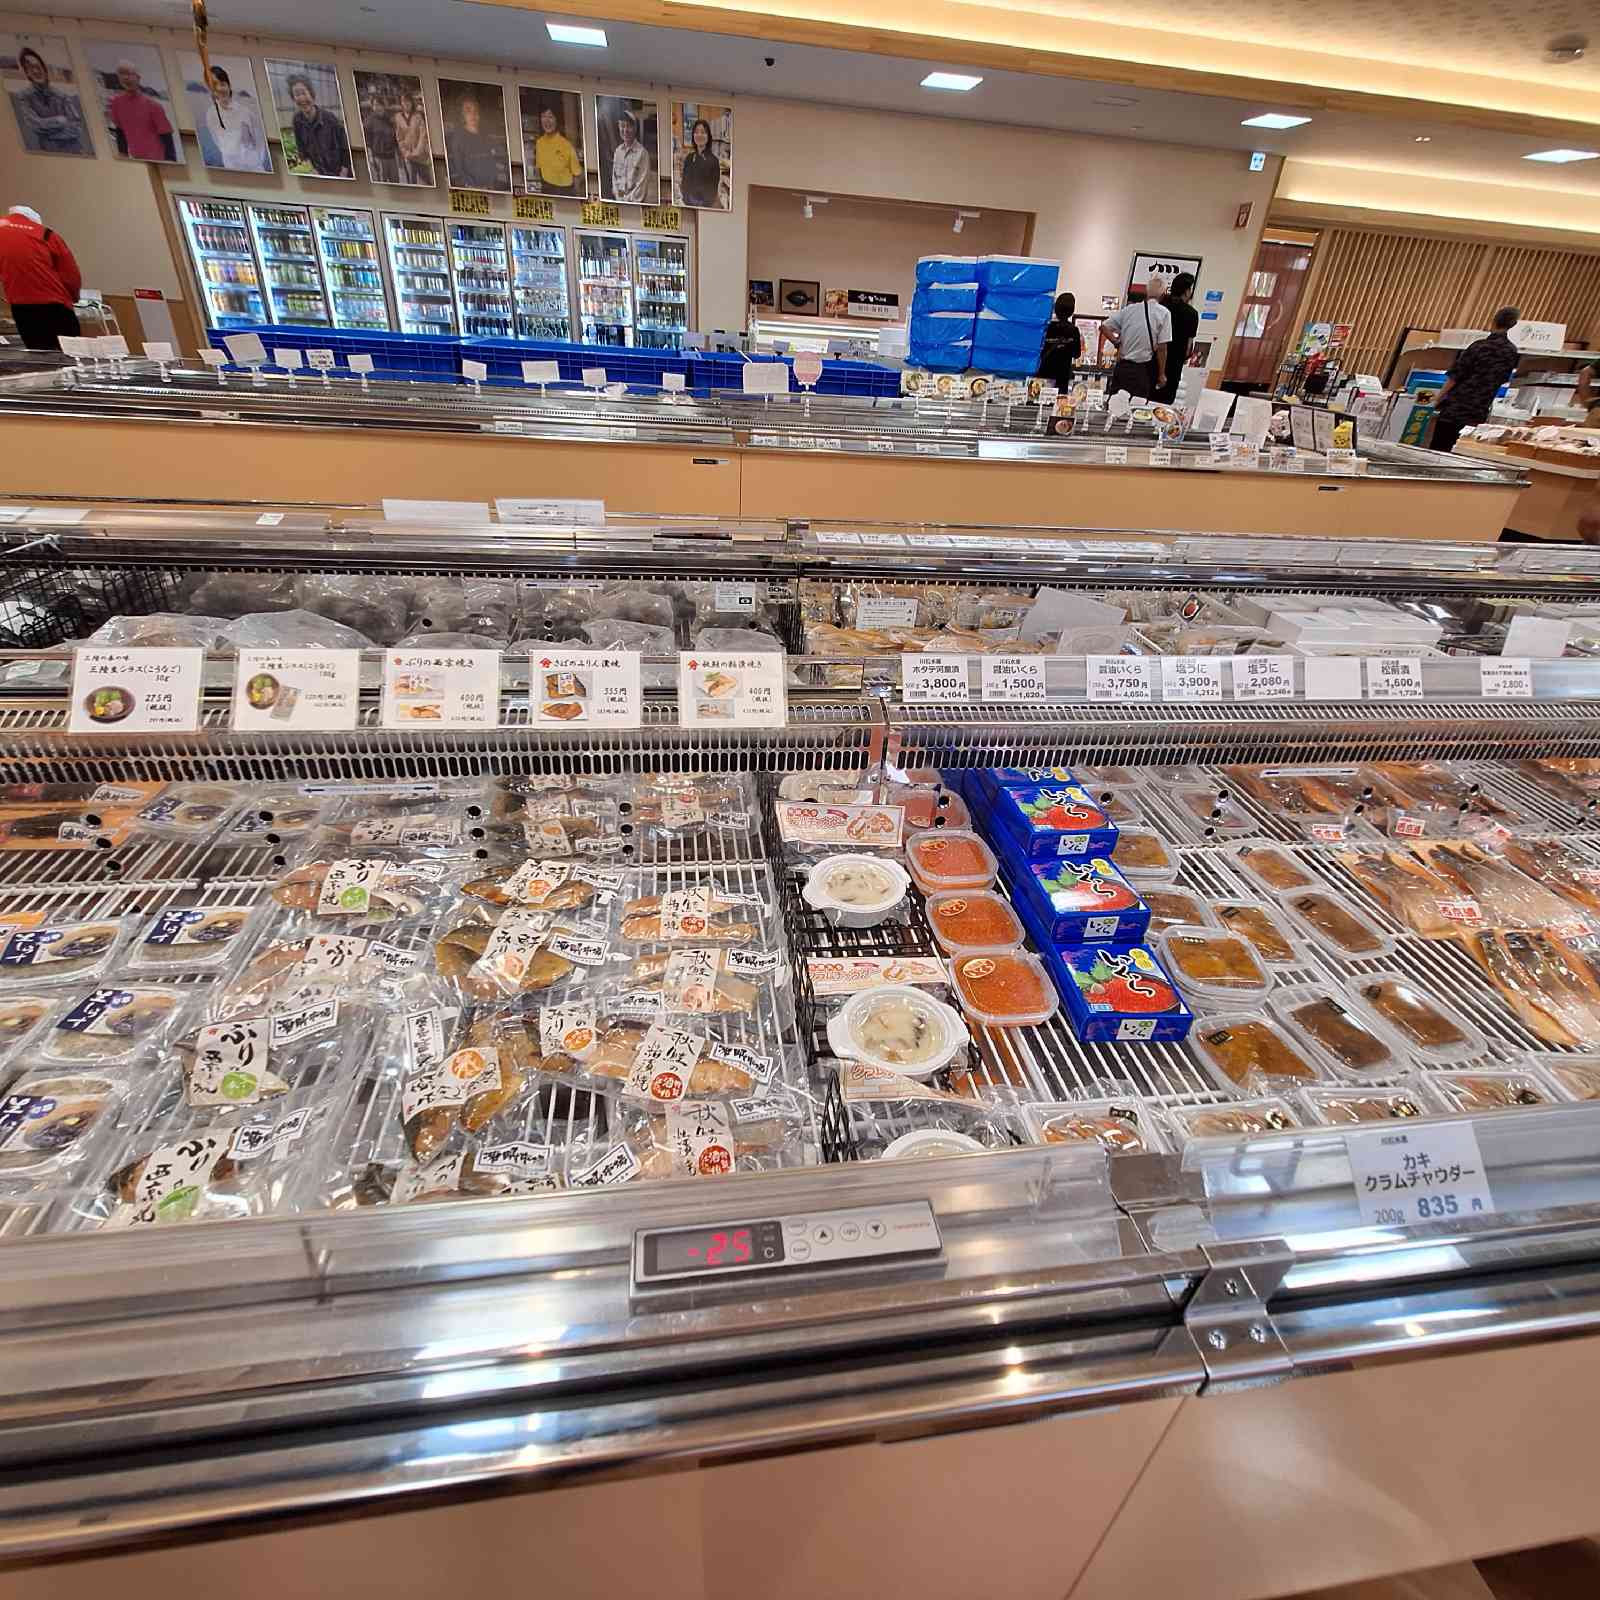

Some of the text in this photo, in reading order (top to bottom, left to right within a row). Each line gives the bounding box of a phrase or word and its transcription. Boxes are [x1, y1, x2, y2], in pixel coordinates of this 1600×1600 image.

[992, 665, 1038, 674] 醤油いくら
[1098, 664, 1142, 674] 醤油いくら
[1176, 663, 1208, 673] 塩うに
[1248, 663, 1279, 674] 塩うに
[1402, 1152, 1430, 1170] カキ
[1365, 1164, 1476, 1192] クラムチャウダー
[1375, 1208, 1406, 1225] 200g
[1417, 1194, 1459, 1218] 835
[687, 1230, 752, 1265] -25
